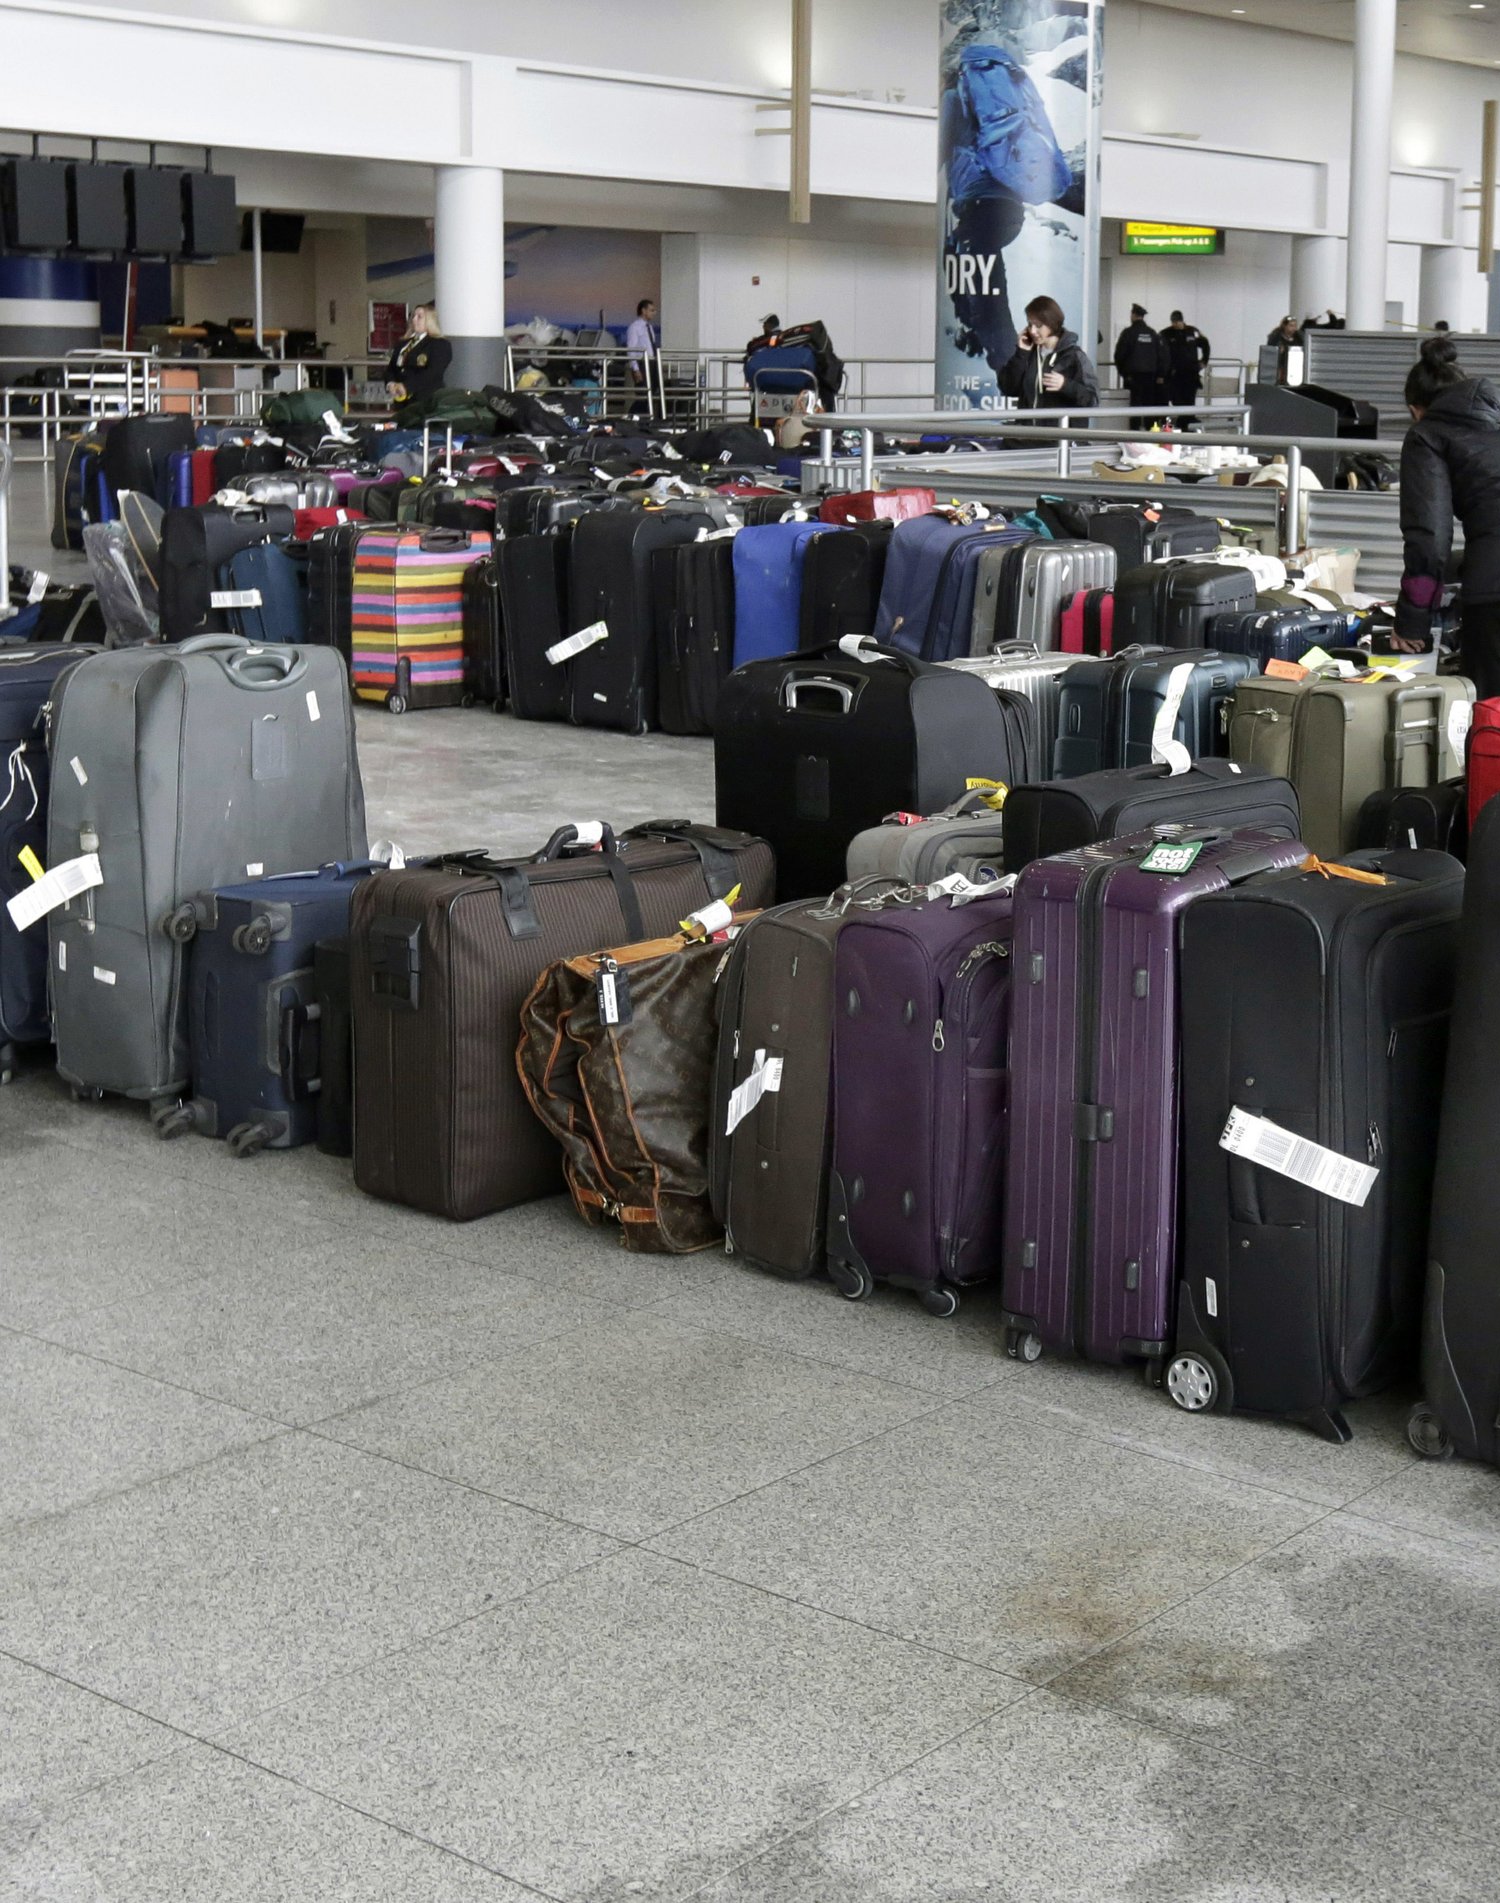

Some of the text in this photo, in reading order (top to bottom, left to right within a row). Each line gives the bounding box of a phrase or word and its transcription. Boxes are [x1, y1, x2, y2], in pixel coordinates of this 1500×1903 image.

[945, 254, 1001, 295] DRY.
[954, 375, 980, 390] THE
[1153, 848, 1194, 859] not
